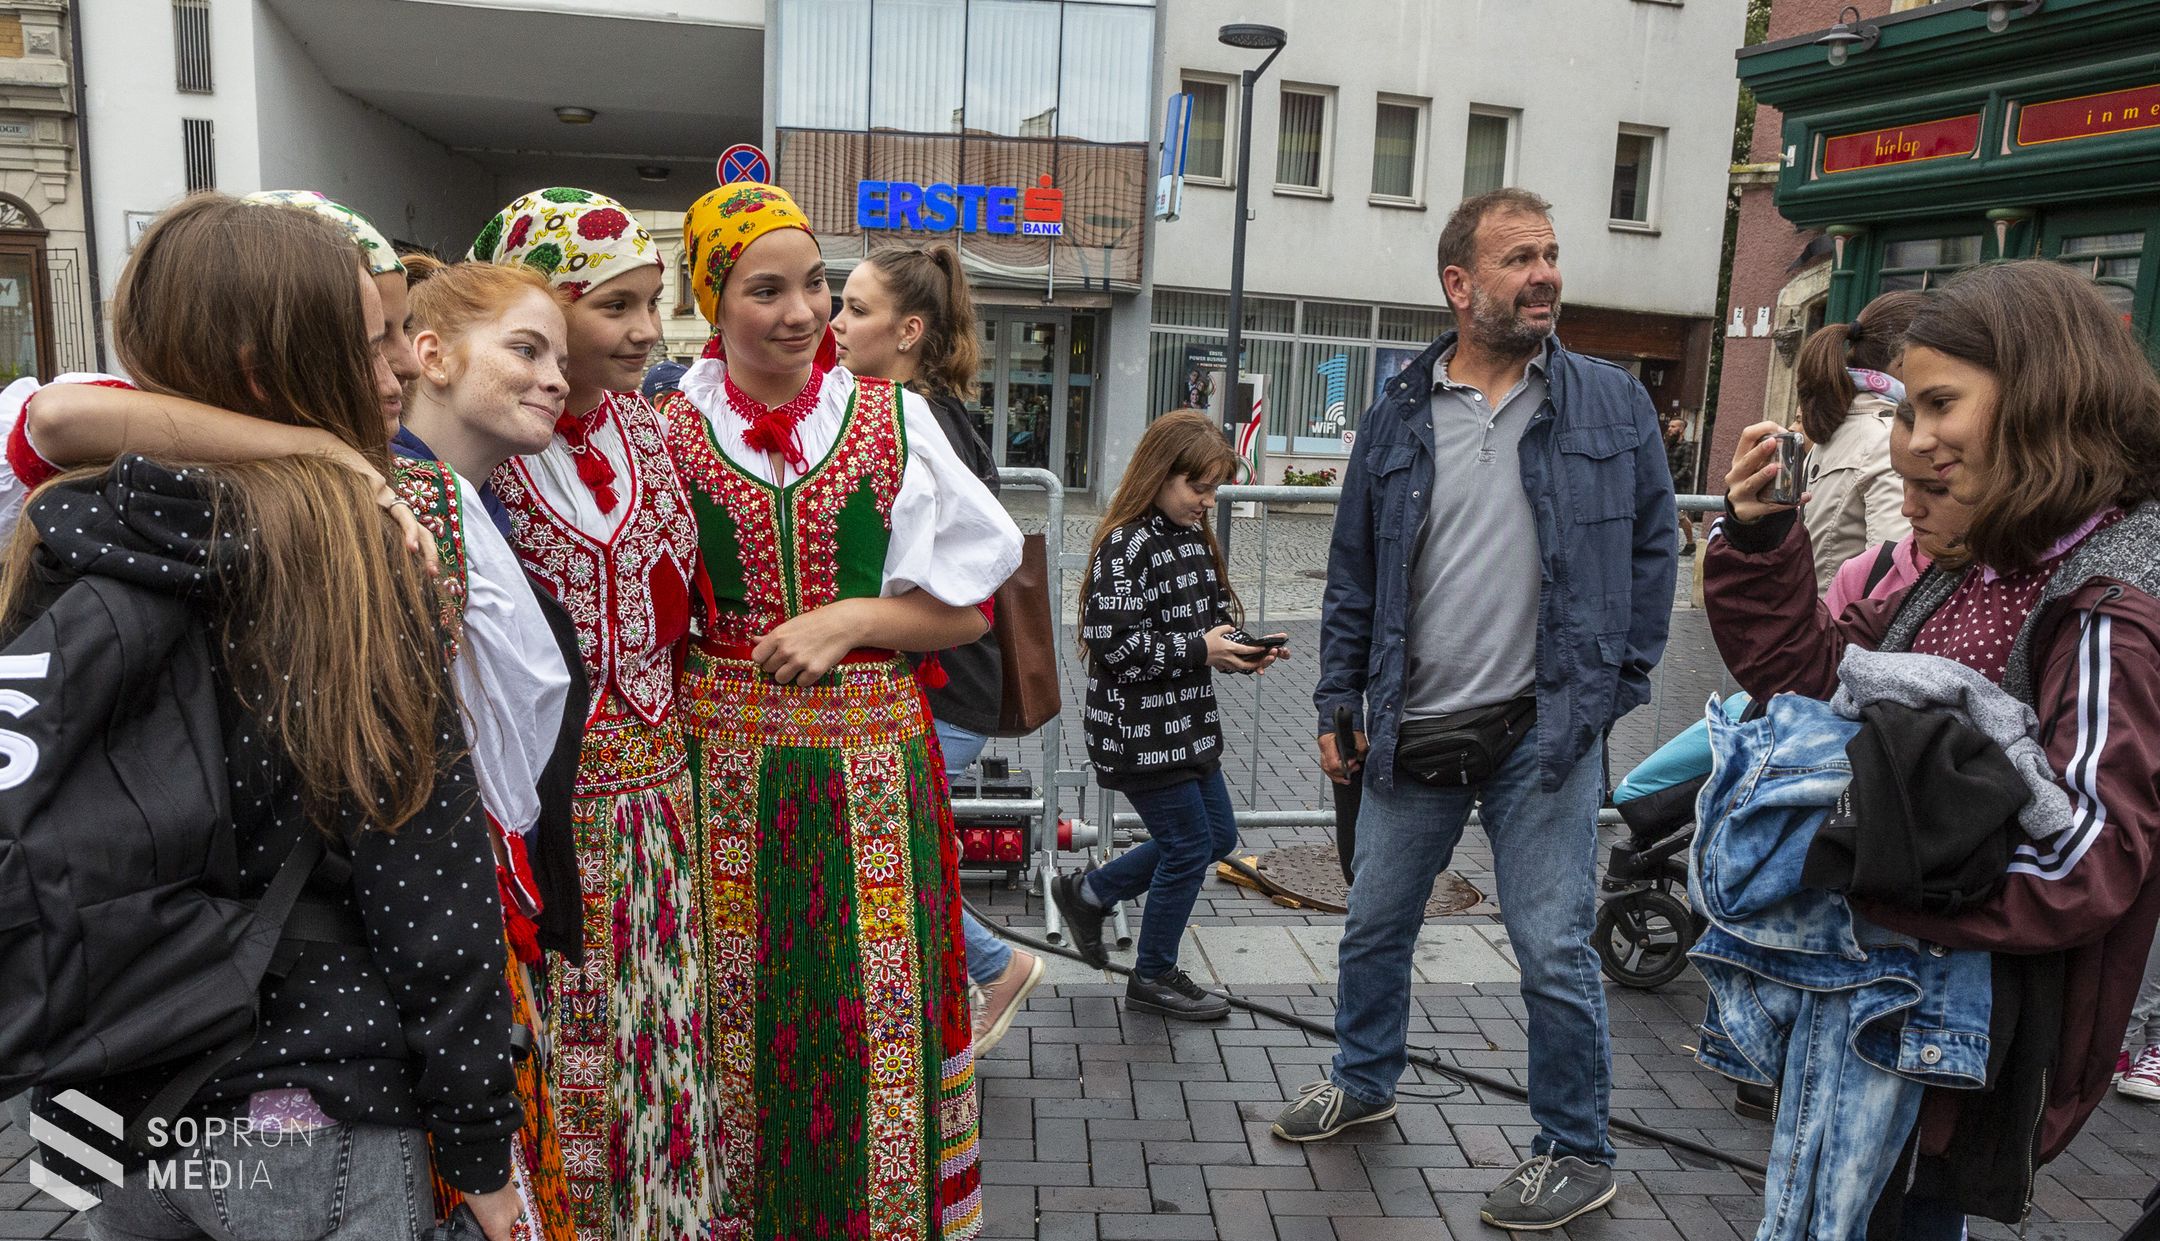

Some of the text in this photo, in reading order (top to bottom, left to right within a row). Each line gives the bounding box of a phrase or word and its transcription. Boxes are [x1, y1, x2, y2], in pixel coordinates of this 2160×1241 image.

[1875, 131, 1920, 157] hírlap
[858, 179, 1017, 235] ERSTE
[1023, 223, 1062, 235] BANK
[1312, 421, 1337, 435] WiFi
[1111, 557, 1126, 578] SAY
[1098, 596, 1144, 611] SAY LESS
[1095, 625, 1113, 639] LESS
[1154, 642, 1166, 664] SAY
[1180, 685, 1199, 703] SAY
[1136, 749, 1170, 766] MORE
[1171, 746, 1187, 762] DO
